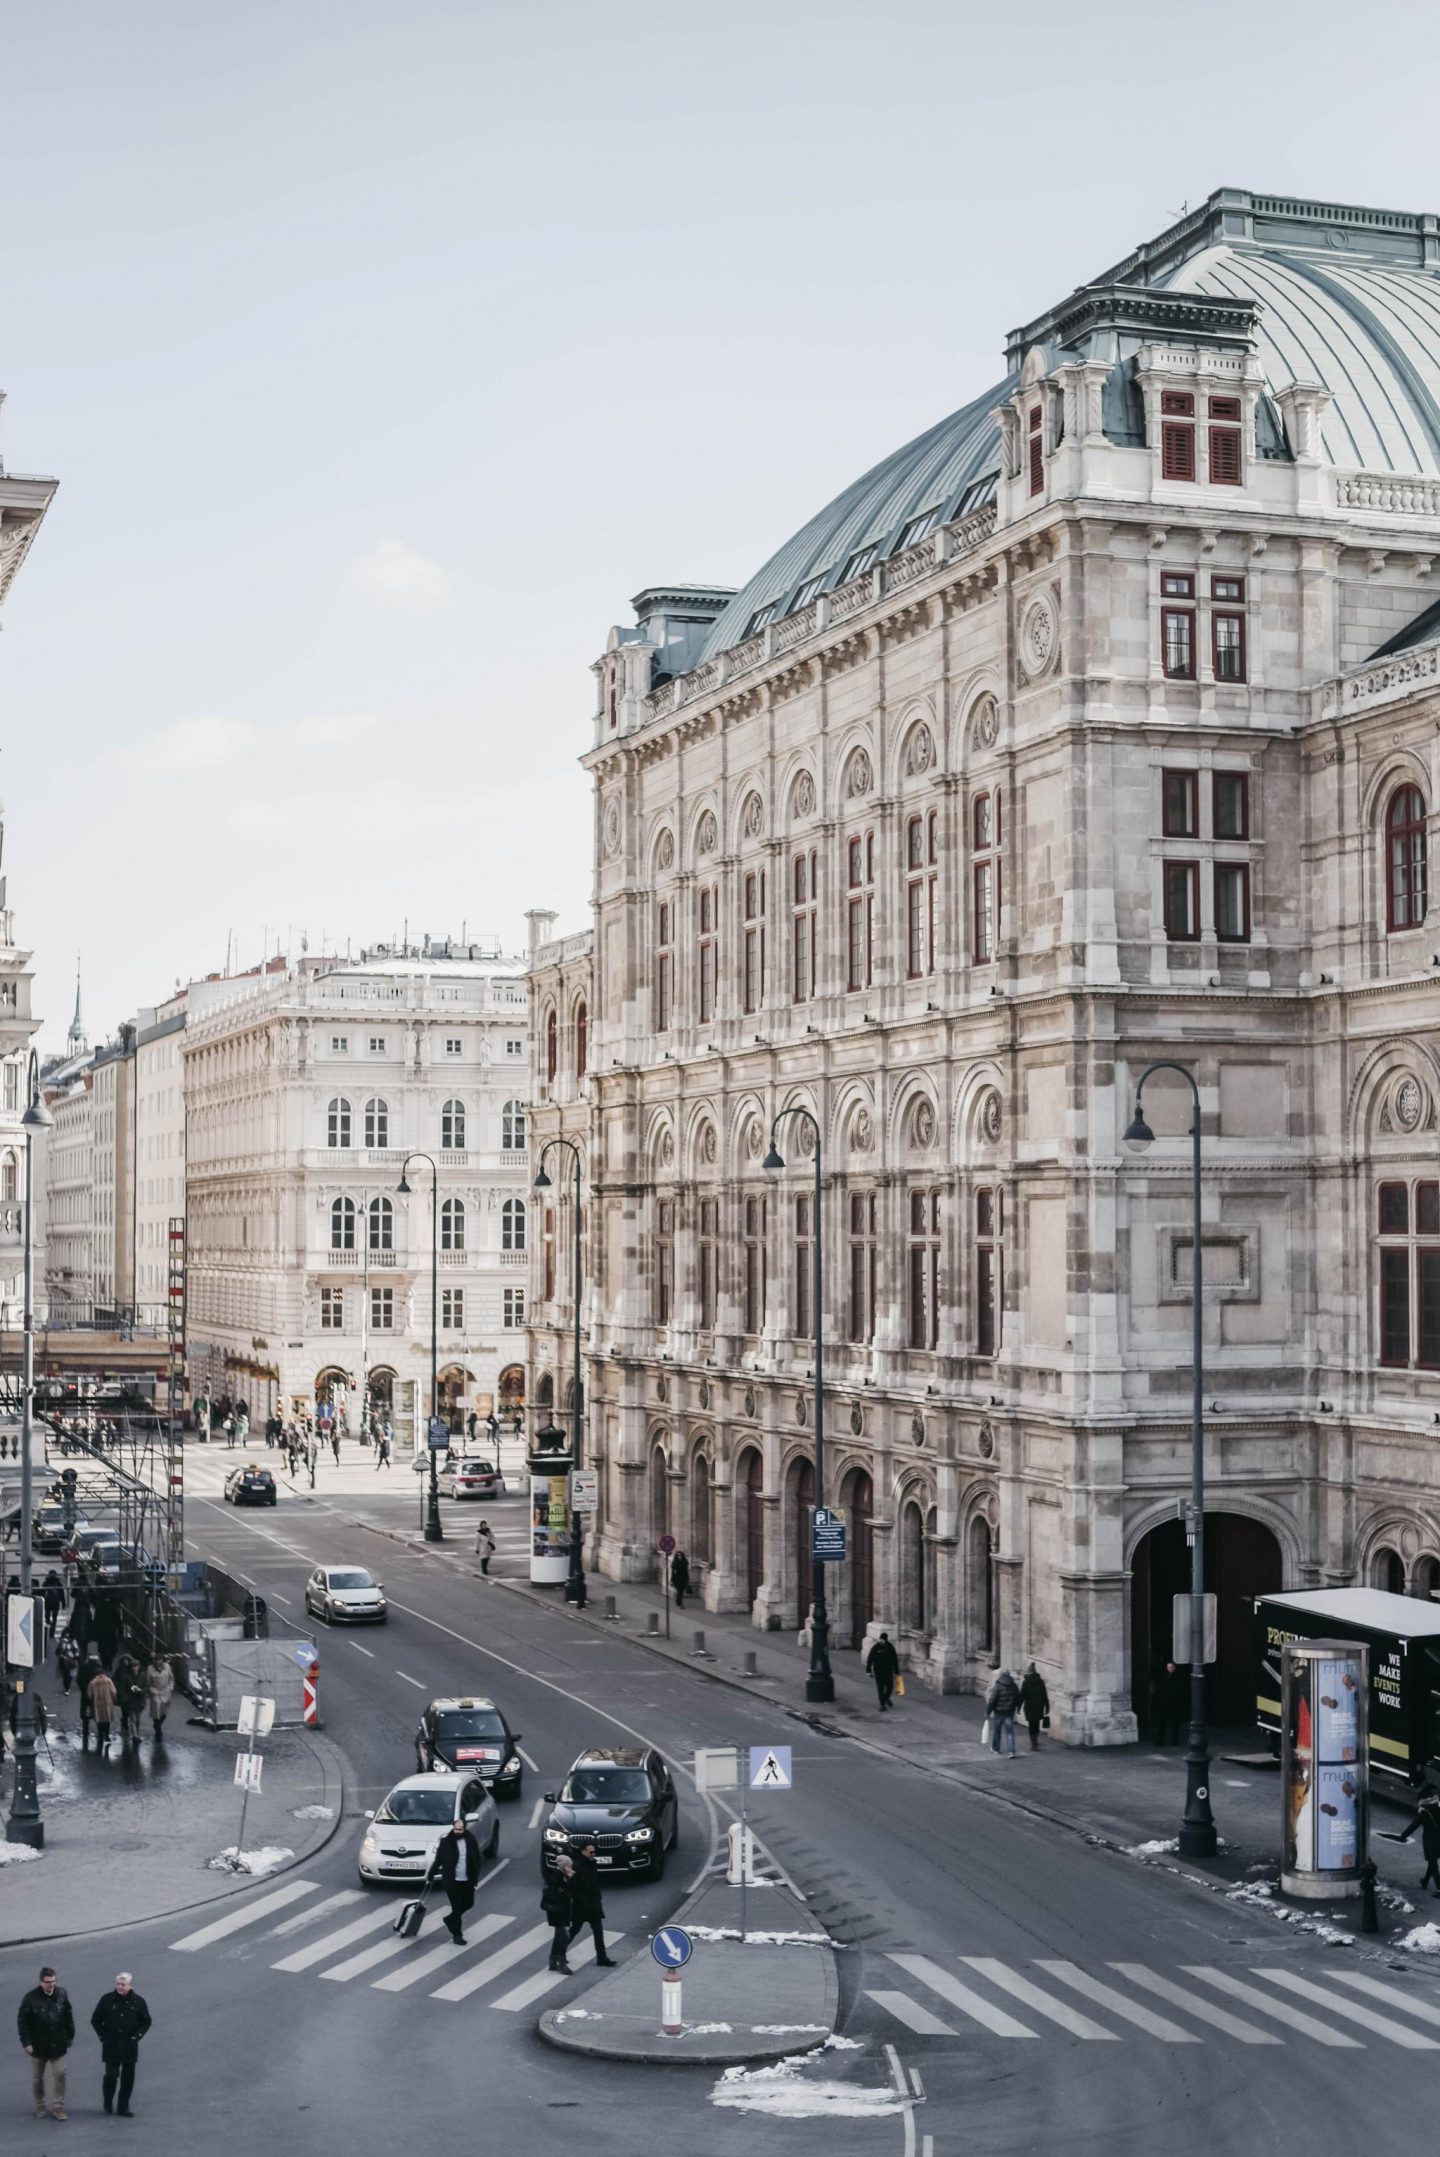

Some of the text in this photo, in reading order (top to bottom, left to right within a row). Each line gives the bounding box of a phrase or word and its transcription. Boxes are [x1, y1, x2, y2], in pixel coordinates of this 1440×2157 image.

[1388, 1652, 1401, 1667] WE
[1378, 1663, 1401, 1681] MAKE
[1373, 1676, 1401, 1694] EVENTS
[1378, 1691, 1401, 1709] WORK
